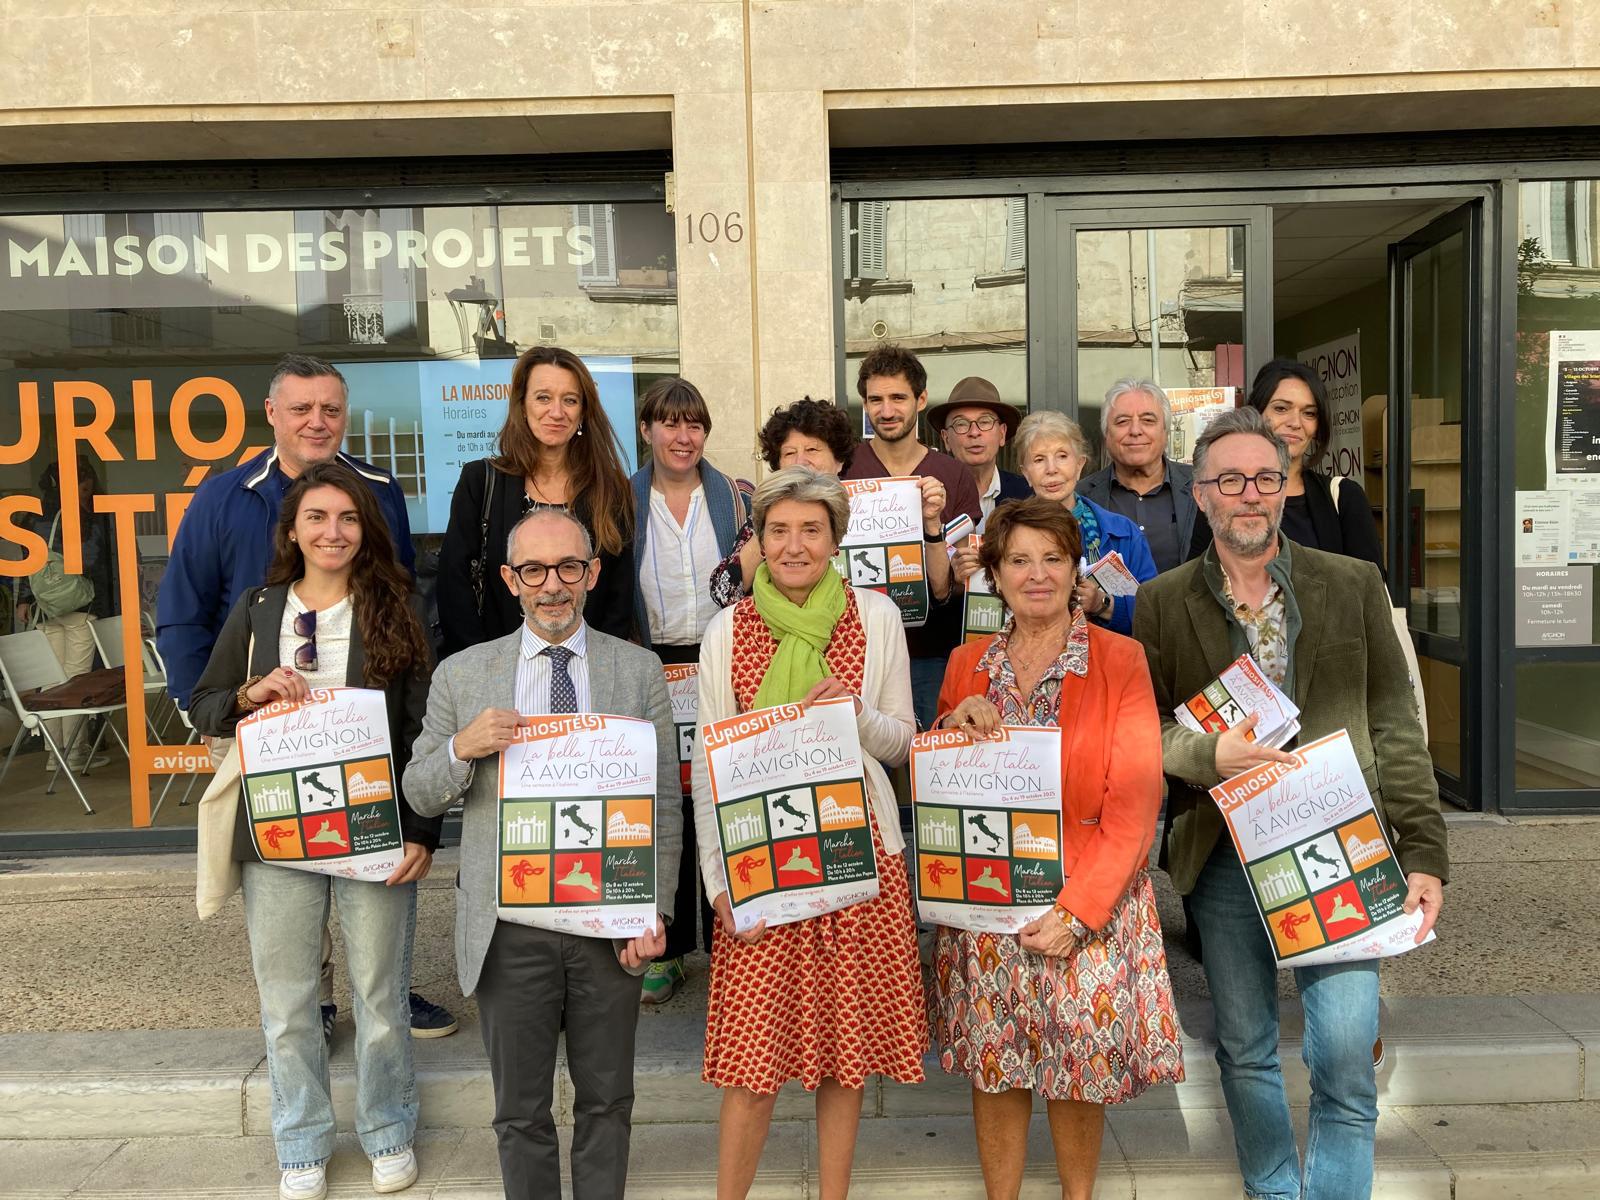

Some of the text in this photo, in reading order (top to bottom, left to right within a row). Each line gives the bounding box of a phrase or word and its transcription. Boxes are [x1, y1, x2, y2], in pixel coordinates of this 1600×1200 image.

[685, 211, 744, 244] 106
[9, 225, 596, 278] MAISON DES PROJETS
[442, 383, 512, 402] LA MAISON
[443, 406, 487, 420] Horaires
[457, 430, 466, 439] Du
[467, 430, 486, 439] mardi
[458, 443, 466, 452] de
[467, 442, 479, 452] 10h
[512, 713, 604, 742] URIOSITÉ(S)
[703, 703, 801, 747] CURIOSITÉ(S)
[277, 726, 372, 755] AVIGNON
[548, 734, 585, 762] bella
[586, 732, 638, 764] Italia
[752, 727, 788, 759] bella
[788, 719, 839, 754] Italia
[539, 762, 638, 781] AVIGNON
[749, 746, 843, 778] AVIGNON
[954, 746, 990, 771] bella
[991, 746, 1041, 775] Italia
[947, 772, 1042, 792] AVIGNON
[350, 805, 381, 825] Marché
[1271, 784, 1354, 833] AVIGNON
[823, 832, 855, 853] Marché
[605, 850, 639, 870] Marché
[1013, 861, 1046, 879] Marché
[1360, 867, 1387, 893] Marché
